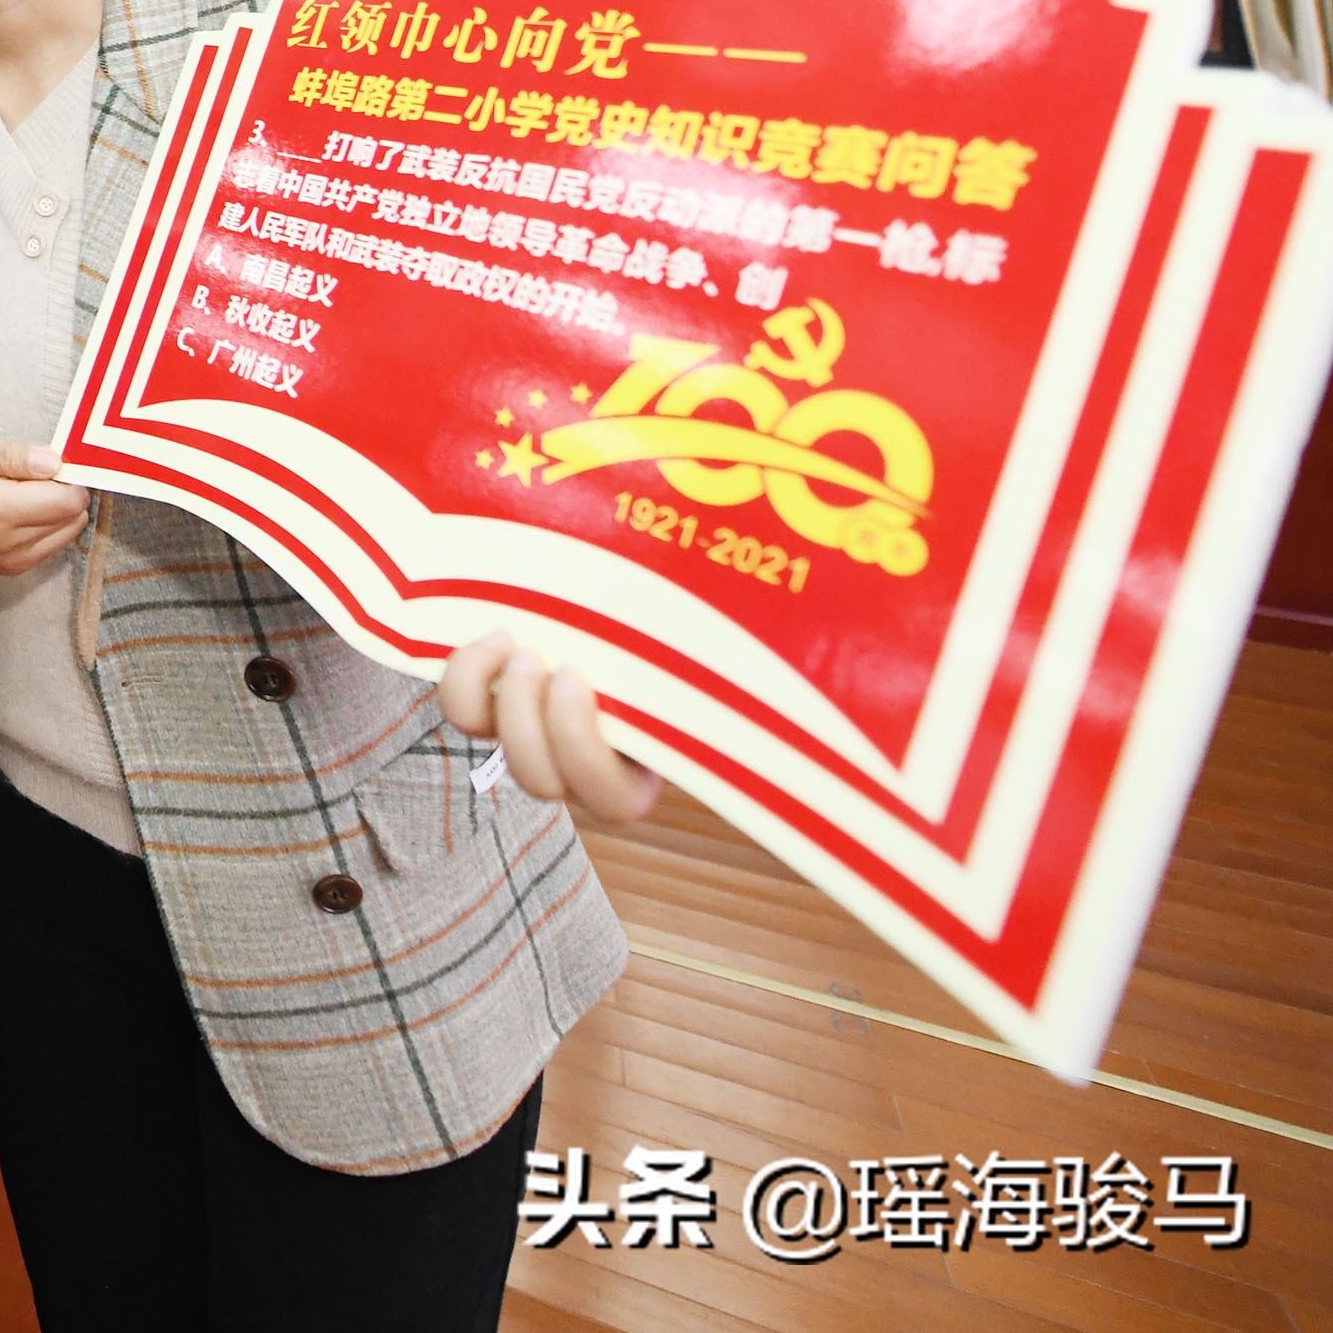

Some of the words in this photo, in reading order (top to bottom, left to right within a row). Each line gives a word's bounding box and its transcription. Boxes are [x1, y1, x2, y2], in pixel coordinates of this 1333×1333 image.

[289, 67, 1037, 211] 蚌埠路第二小学党史知识竞赛问答
[614, 491, 811, 594] 1921-2021
